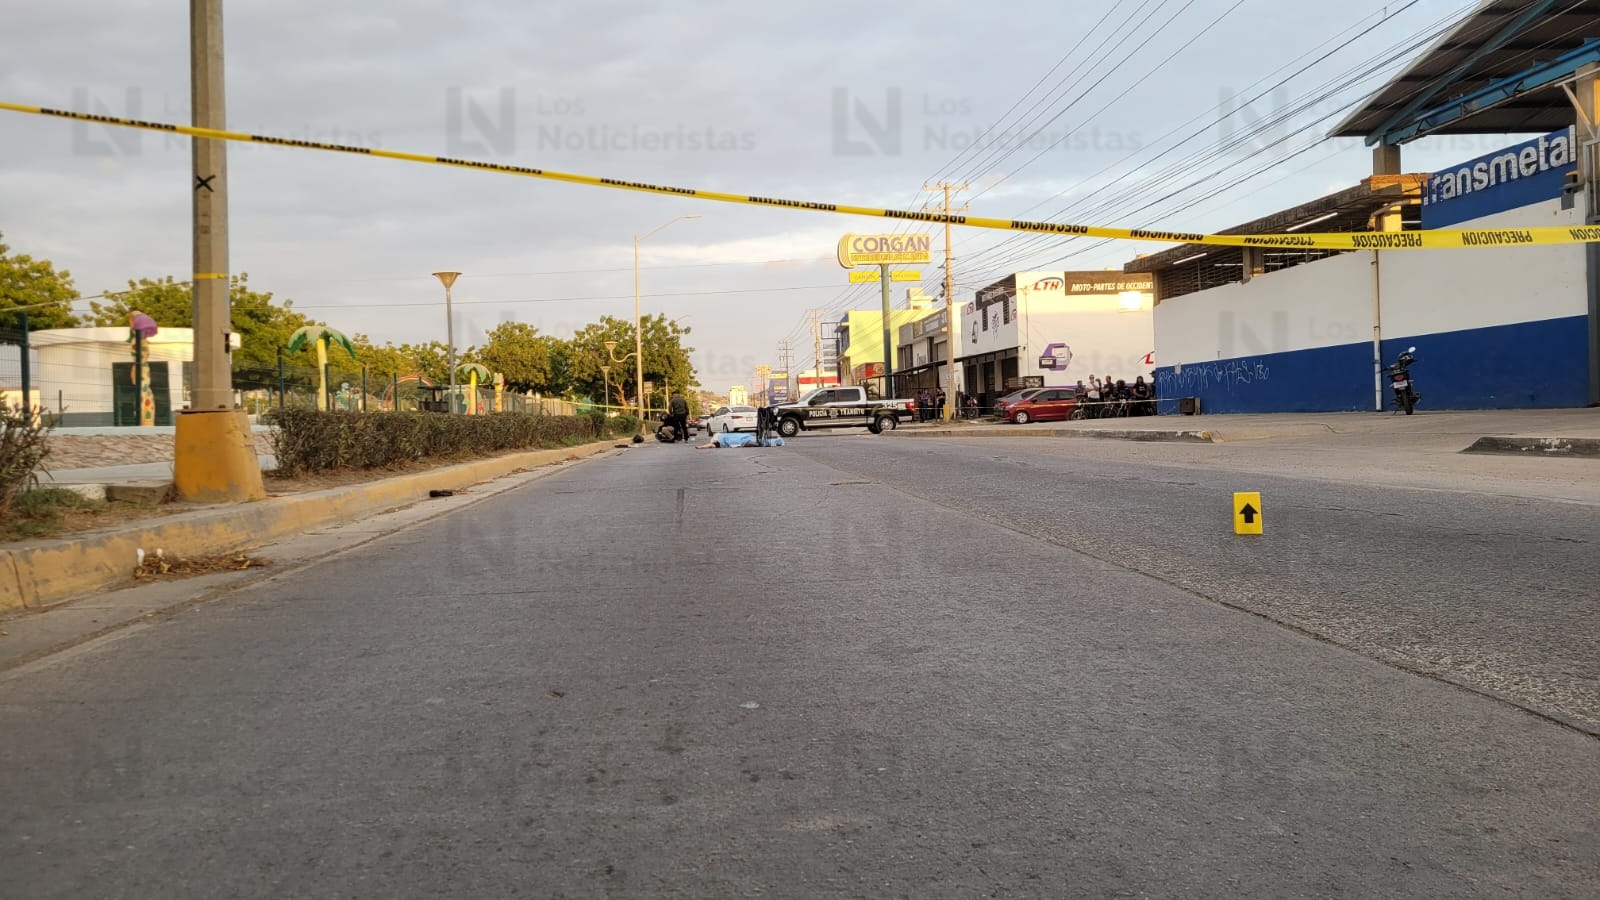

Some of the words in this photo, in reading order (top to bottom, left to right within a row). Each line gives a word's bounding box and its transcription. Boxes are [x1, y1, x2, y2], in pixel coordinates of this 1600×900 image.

[853, 236, 930, 253] CORGAN
[1351, 233, 1422, 249] PRECAUCION
[1461, 230, 1533, 246] PRECAUCION
[1033, 280, 1060, 291] LTH
[1071, 282, 1116, 292] MOTO-PARTES
[1116, 281, 1125, 290] DE
